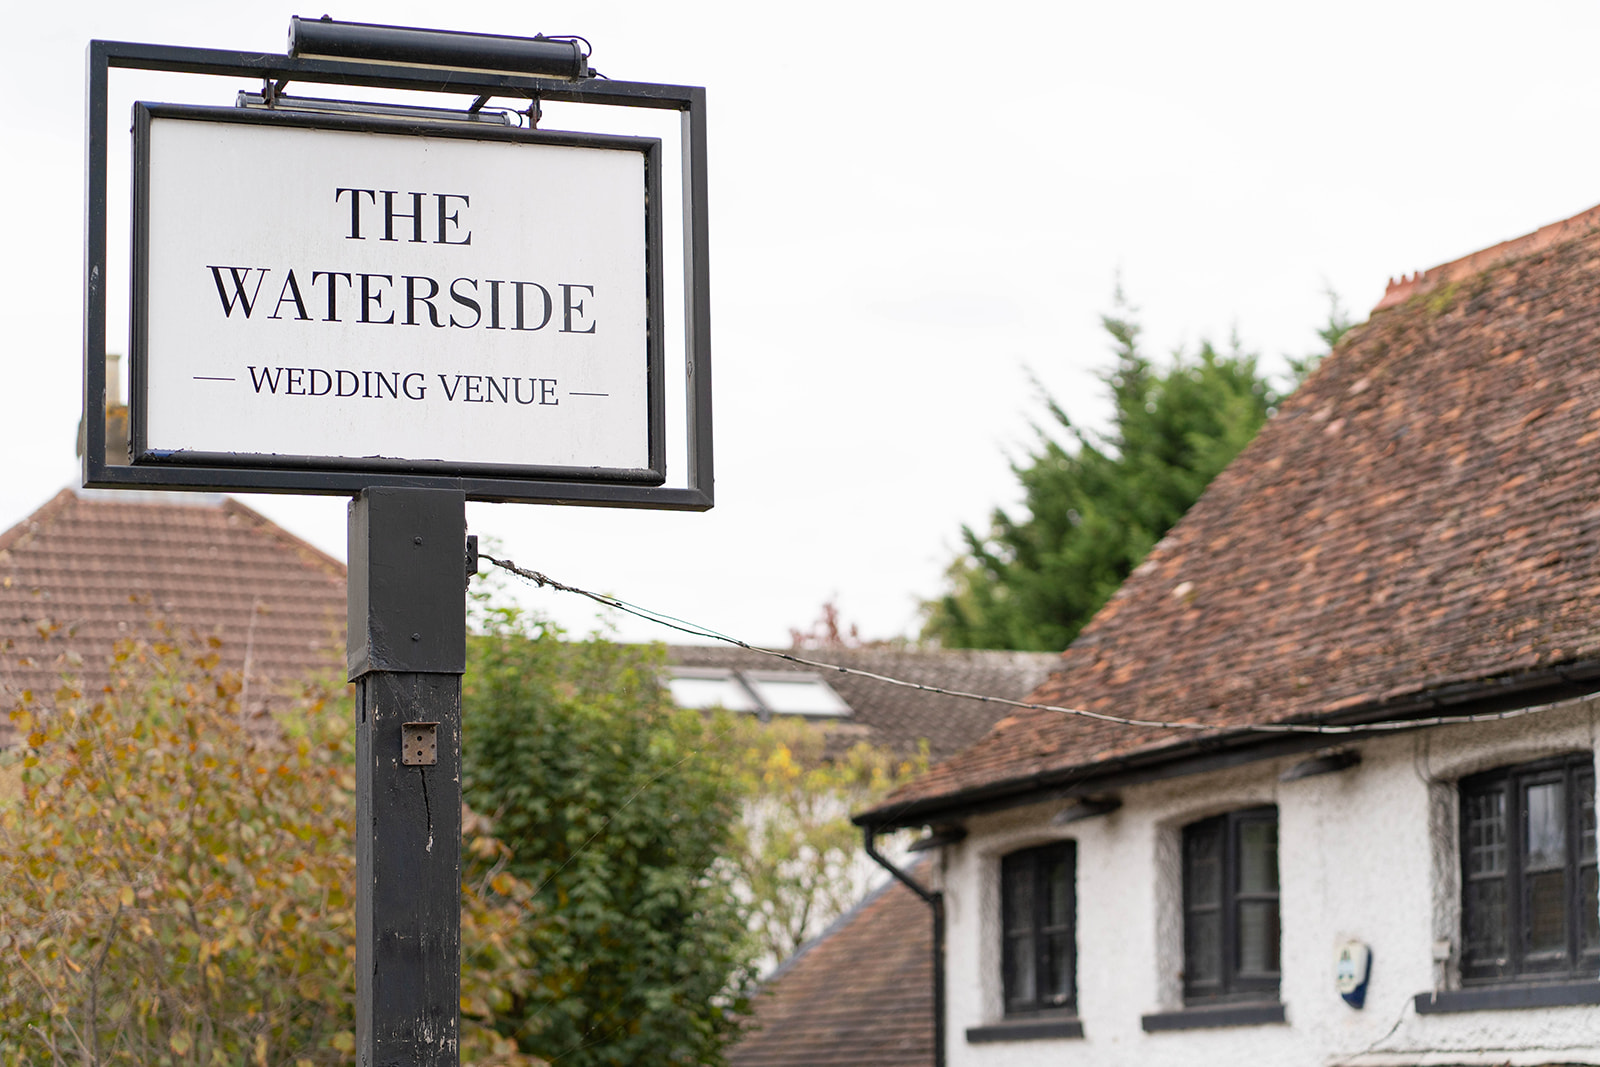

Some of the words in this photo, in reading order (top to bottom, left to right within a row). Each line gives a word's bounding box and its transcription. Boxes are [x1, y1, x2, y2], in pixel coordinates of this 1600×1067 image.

[335, 187, 472, 246] THE
[205, 265, 596, 334] WATERSIDE
[246, 366, 427, 401] WEDDING
[438, 374, 560, 406] VENUE
